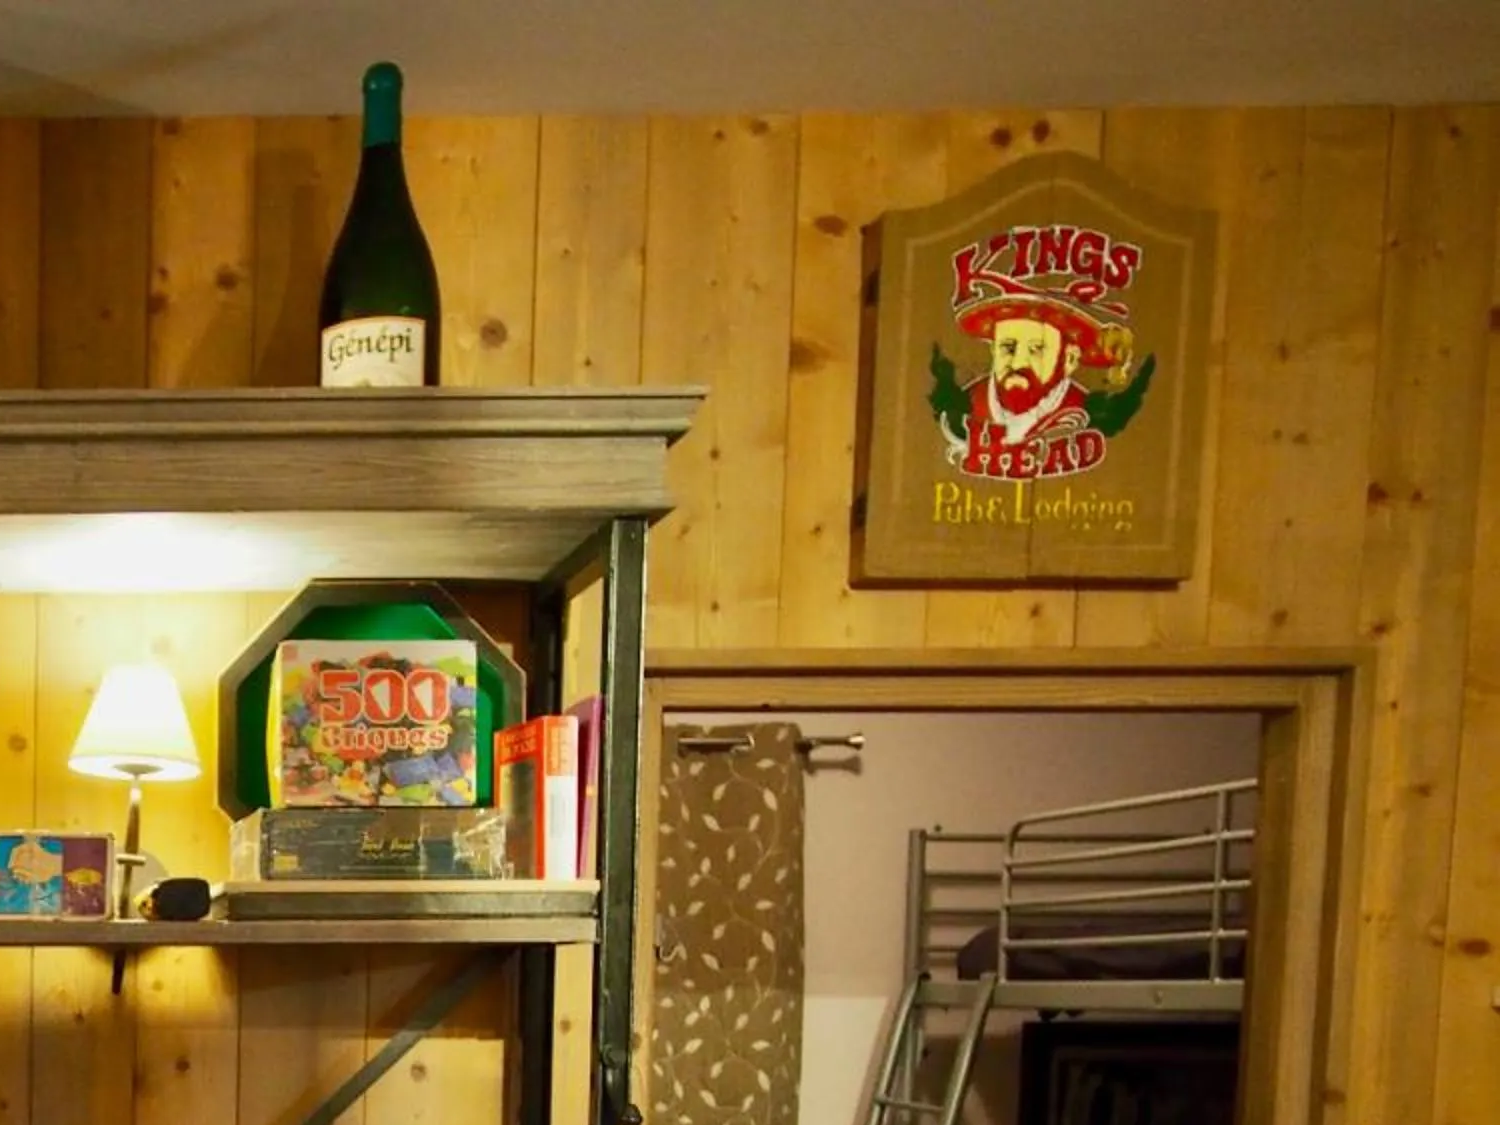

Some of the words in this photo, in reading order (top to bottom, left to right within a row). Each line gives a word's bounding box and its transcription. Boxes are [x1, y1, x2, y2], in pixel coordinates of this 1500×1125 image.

[953, 224, 1142, 312] KINGS
[328, 325, 415, 371] Génépi
[960, 413, 1106, 482] HEAD
[319, 668, 451, 725] 500
